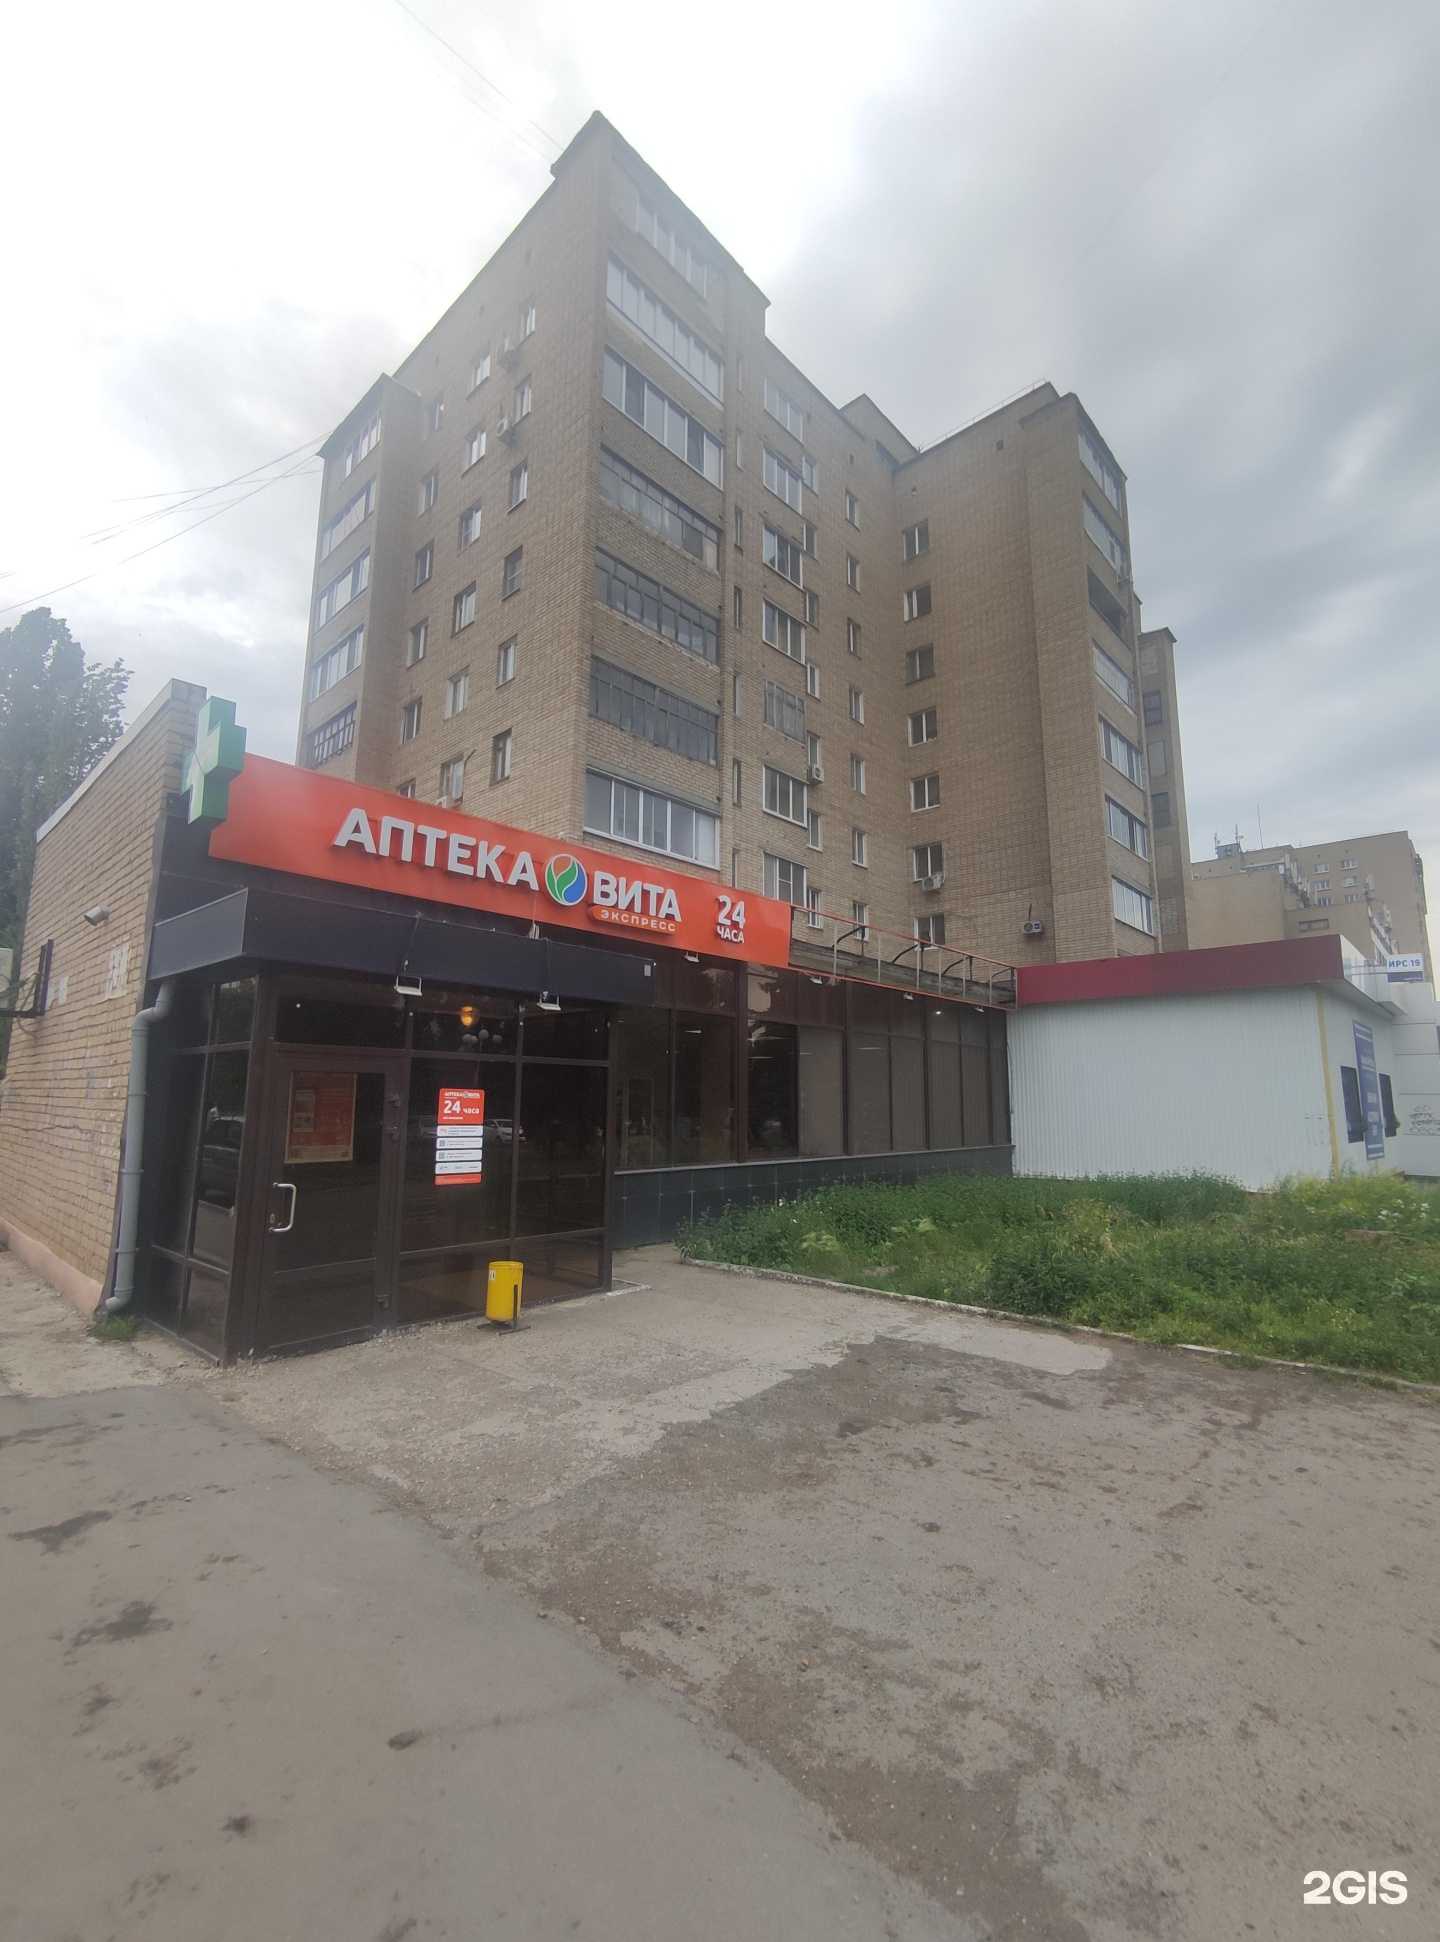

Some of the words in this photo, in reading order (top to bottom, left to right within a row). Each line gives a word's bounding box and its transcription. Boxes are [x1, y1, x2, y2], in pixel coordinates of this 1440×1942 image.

[334, 807, 539, 890] АПТЕКА
[593, 870, 682, 923] ВИТА
[600, 909, 677, 932] ЭКСПРЕСС
[717, 894, 747, 929] 24
[716, 925, 745, 944] ЧАСА
[443, 1100, 461, 1114] 24
